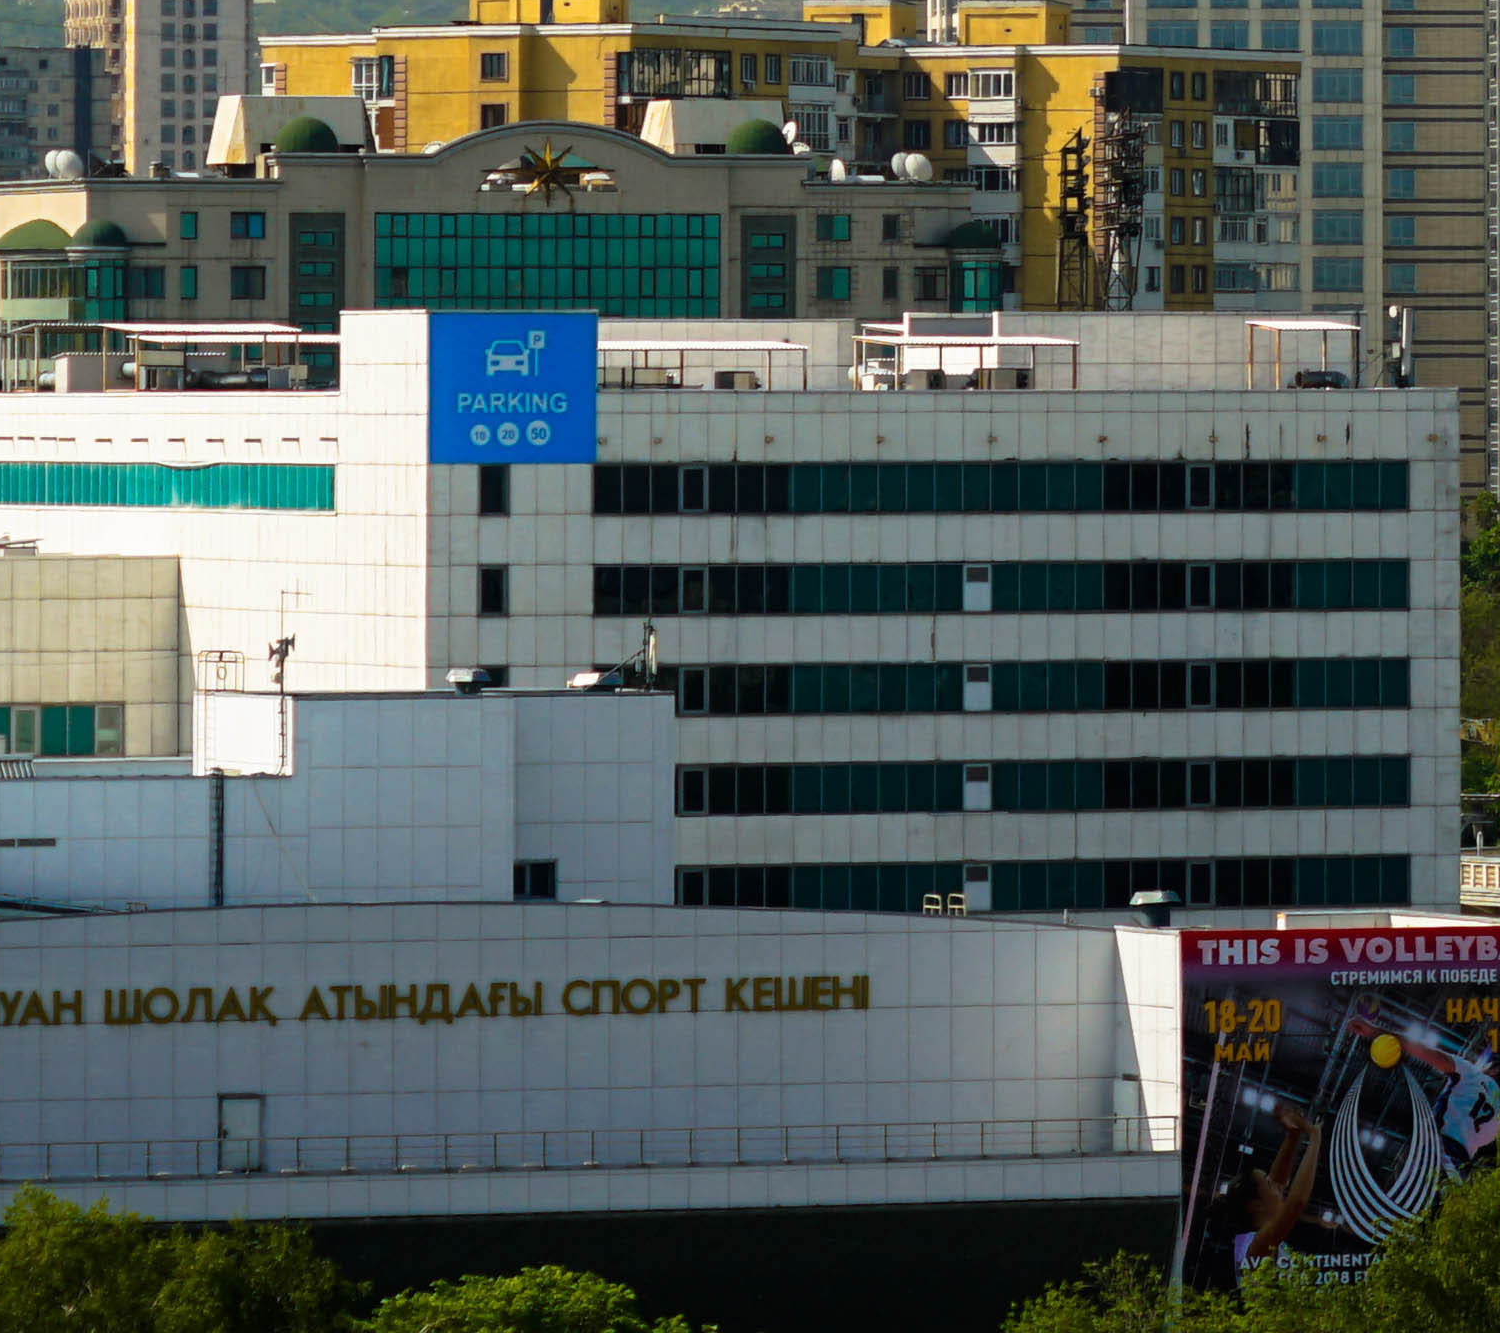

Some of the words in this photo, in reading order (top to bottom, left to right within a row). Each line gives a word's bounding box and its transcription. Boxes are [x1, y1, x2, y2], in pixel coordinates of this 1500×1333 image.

[457, 392, 568, 414] PARKING
[502, 429, 516, 440] 20
[531, 428, 547, 440] 50
[1197, 937, 1281, 965] THIS
[1295, 937, 1329, 964] IS
[1331, 970, 1422, 985] СТРЕМИМСЯ
[1426, 970, 1437, 983] К
[1440, 969, 1497, 985] ПОБЕДЕ
[104, 986, 277, 1026] ШОЛАҚ
[299, 981, 543, 1025] АТЫНДАҒЫ
[561, 977, 707, 1015] СПОРТ
[724, 974, 870, 1012] КЕШЕНІ
[1204, 999, 1282, 1033] 18-20
[1214, 1039, 1271, 1062] МАЙ
[1276, 1252, 1391, 1269] CNTINENTA
